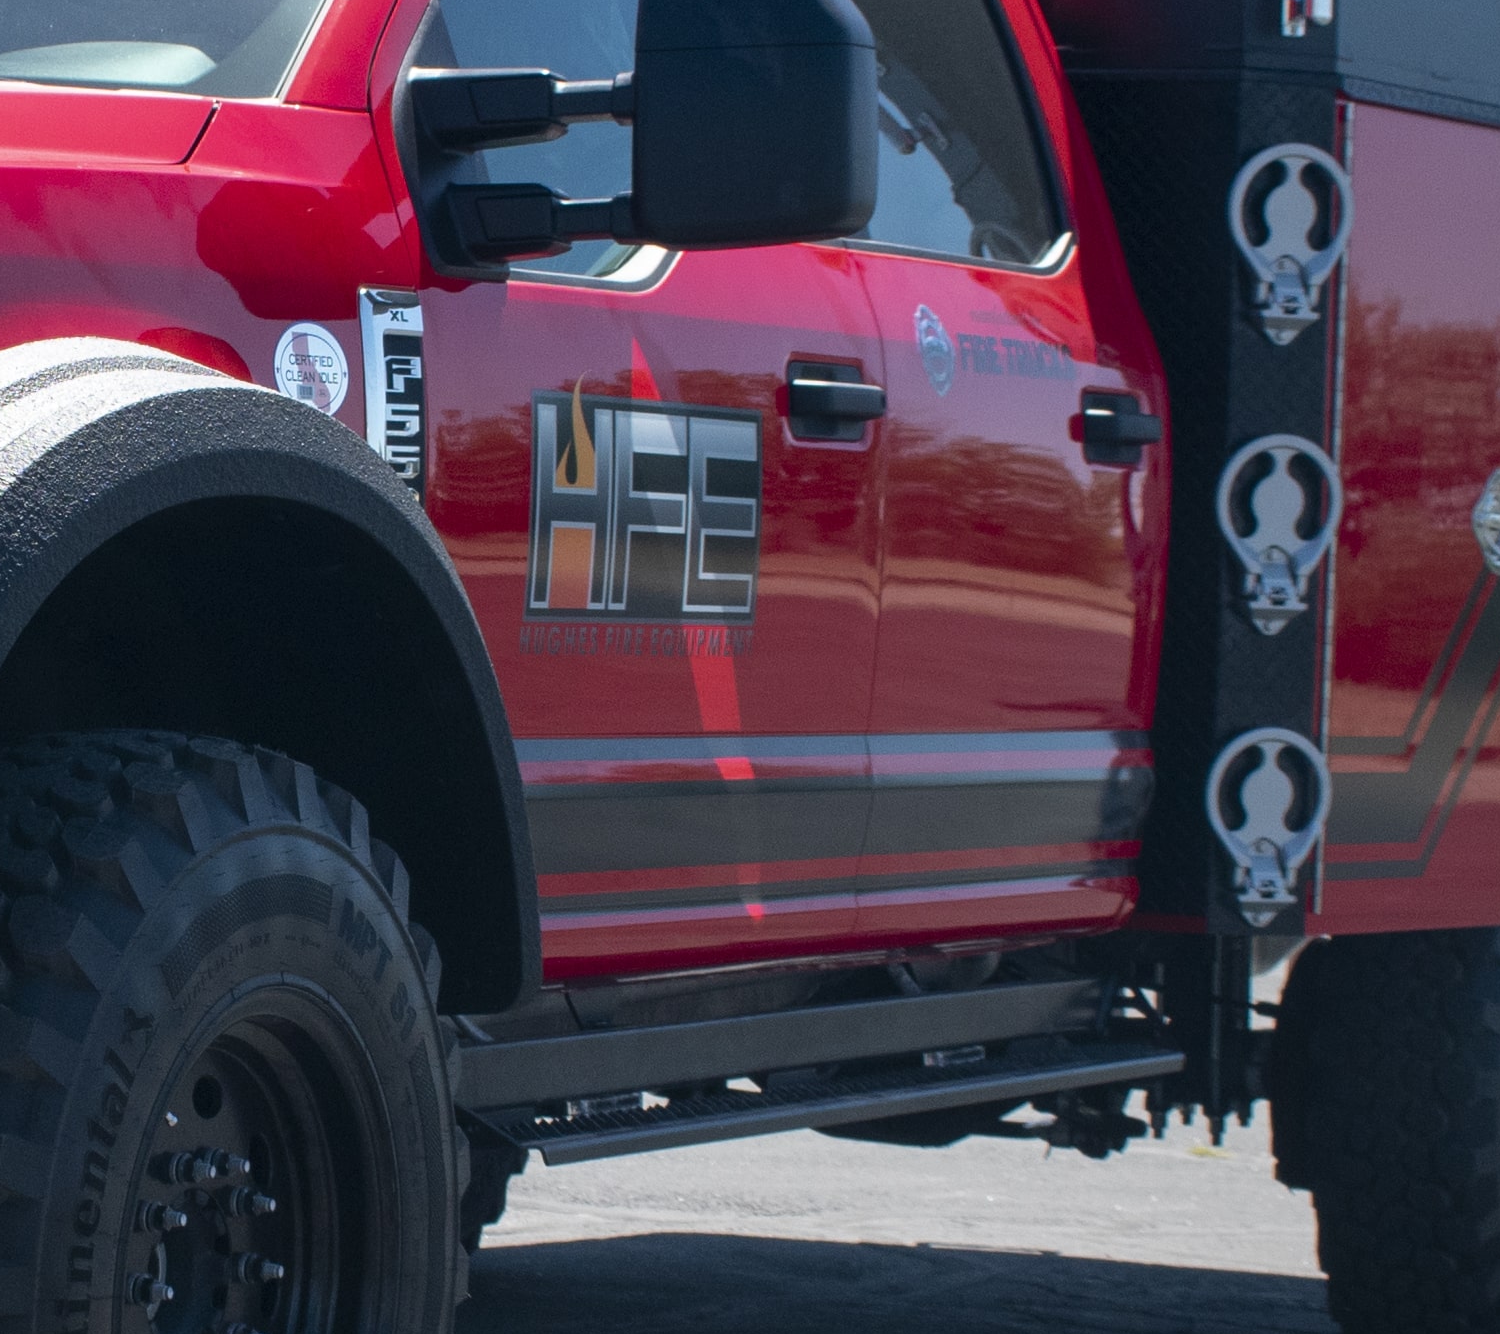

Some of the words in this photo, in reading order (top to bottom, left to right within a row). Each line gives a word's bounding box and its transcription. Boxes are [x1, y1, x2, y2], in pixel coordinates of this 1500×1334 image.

[389, 310, 409, 323] XL
[288, 353, 334, 369] CERTIFIED
[285, 369, 316, 384] CLEAN
[319, 370, 339, 385] IDLE
[385, 355, 422, 503] F55
[529, 403, 758, 613] HFE
[519, 626, 598, 655] HUGHES
[604, 628, 644, 656] FIRE
[652, 628, 755, 658] EQUIPMENT
